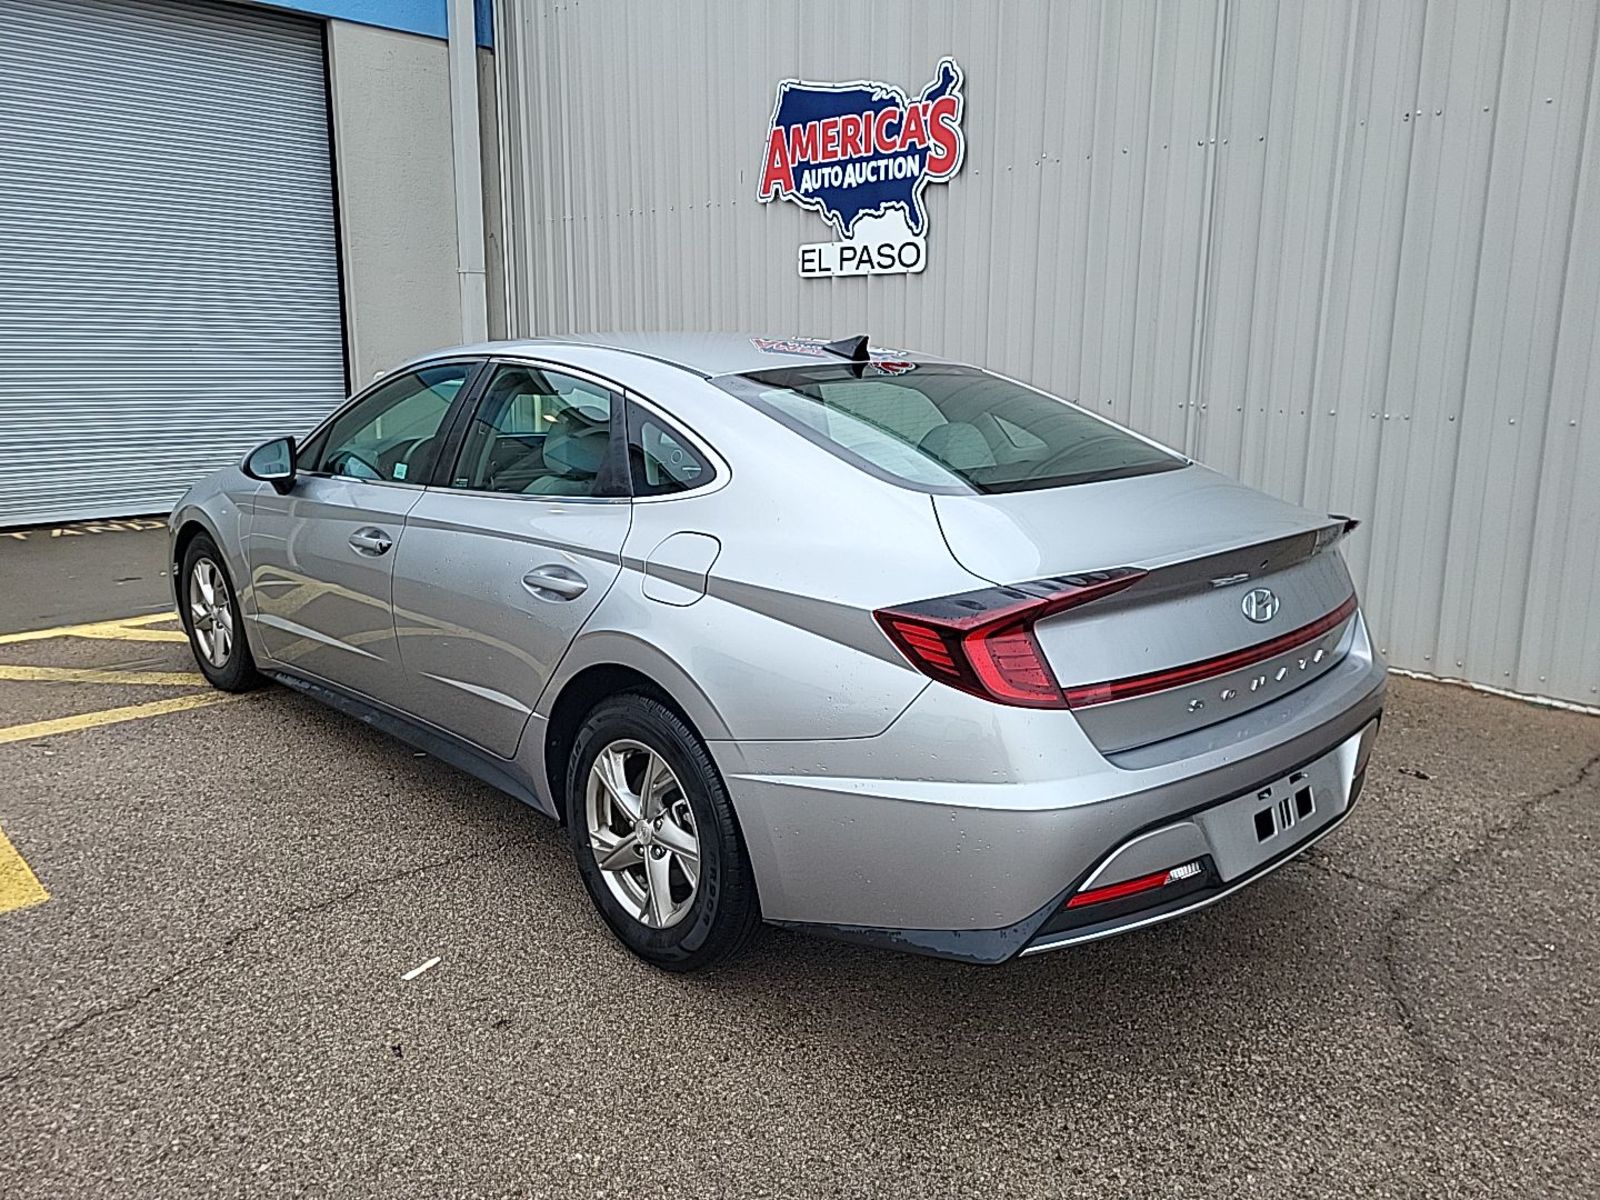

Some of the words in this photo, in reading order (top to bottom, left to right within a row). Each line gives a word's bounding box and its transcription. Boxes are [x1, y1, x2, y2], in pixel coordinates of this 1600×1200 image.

[761, 97, 959, 195] AMERICA'S
[799, 166, 843, 194] AUTO
[843, 154, 920, 189] AUCTION
[801, 248, 832, 273] EL
[839, 241, 921, 271] PASO
